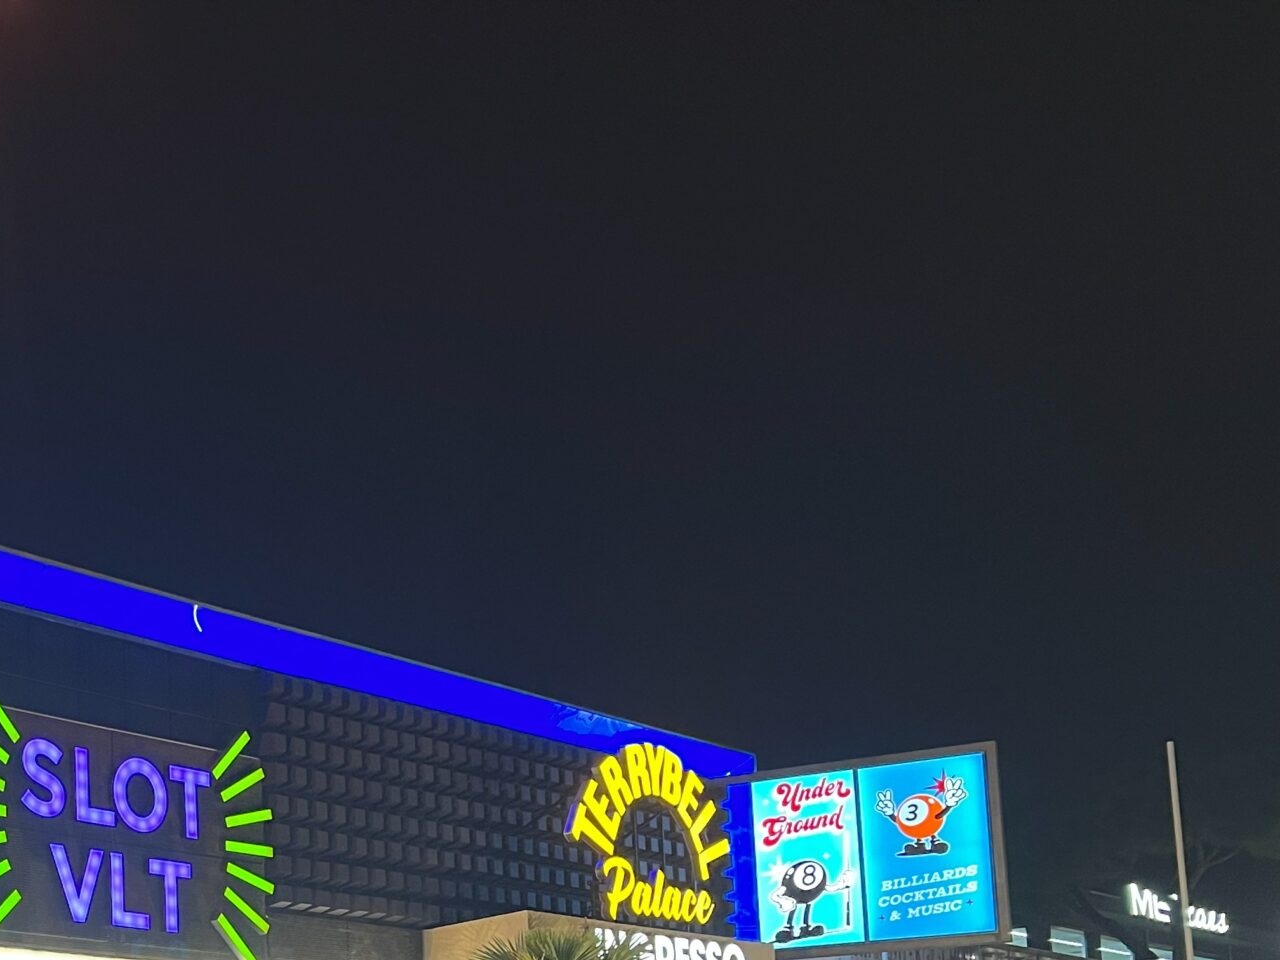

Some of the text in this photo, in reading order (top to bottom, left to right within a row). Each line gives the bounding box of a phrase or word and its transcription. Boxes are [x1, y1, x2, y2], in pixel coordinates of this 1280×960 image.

[21, 737, 211, 840] SLOT
[776, 777, 851, 812] Under
[570, 742, 730, 882] TERRYBELL
[762, 805, 844, 847] Ground
[49, 843, 193, 935] VLT
[603, 857, 715, 925] Palace
[802, 864, 817, 887] 8
[878, 880, 978, 908] COCKTAILS
[880, 864, 978, 892] BILLIARDS
[907, 899, 963, 919] MUSIC
